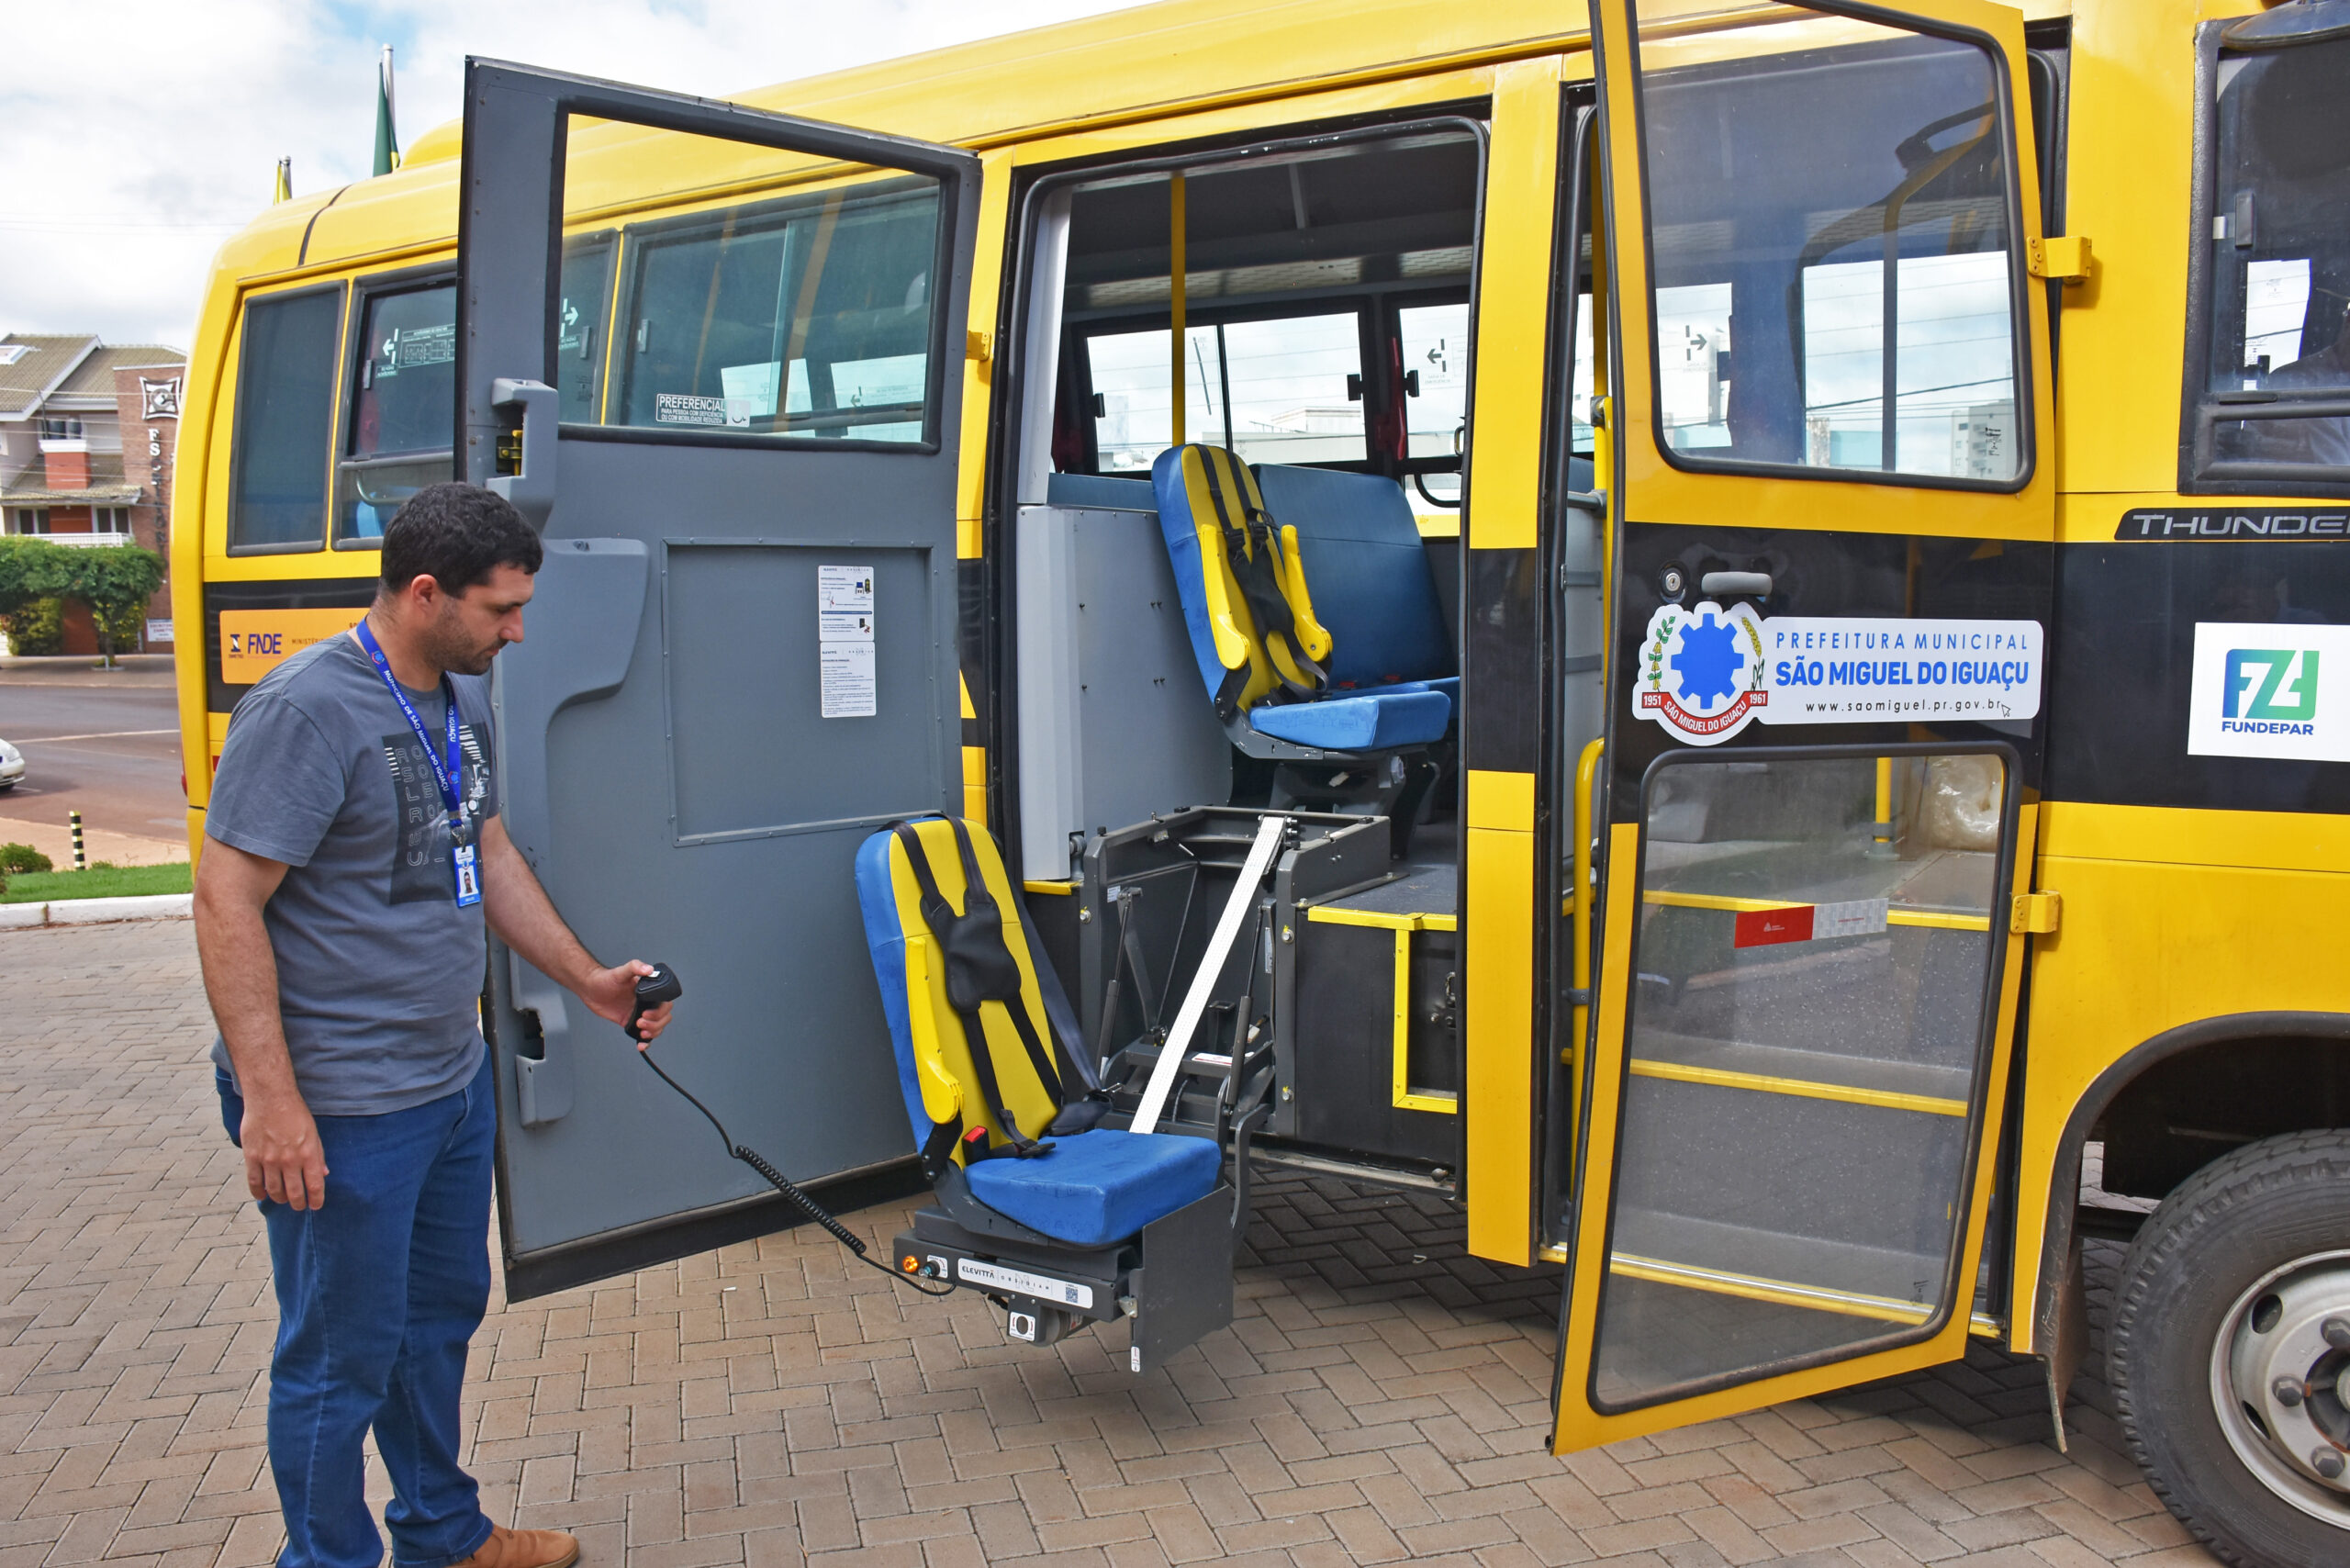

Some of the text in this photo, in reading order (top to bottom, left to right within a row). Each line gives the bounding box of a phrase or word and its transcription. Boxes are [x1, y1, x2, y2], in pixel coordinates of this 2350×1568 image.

[659, 396, 726, 412] PREFERENCIAL
[2132, 514, 2350, 535] THUNDE
[247, 633, 283, 655] FNDE
[1776, 632, 2027, 650] PREFEITURA MUNICIPAL
[1775, 655, 2029, 691] SÃO MIGUEL DO IGUAÇU
[1643, 695, 1662, 706] 1951
[1750, 693, 1766, 704] 1961
[1806, 699, 2000, 713] www.saomiguel.pr.gov.br
[1663, 700, 1747, 732] SÃO MIGUEL DO IGUAÇU
[384, 670, 450, 792] MUNICÍPIO DE SÃO MIGUEL DO IGUAÇU
[448, 715, 457, 743] IGUAÇU
[2221, 721, 2314, 735] FUNDEPAR
